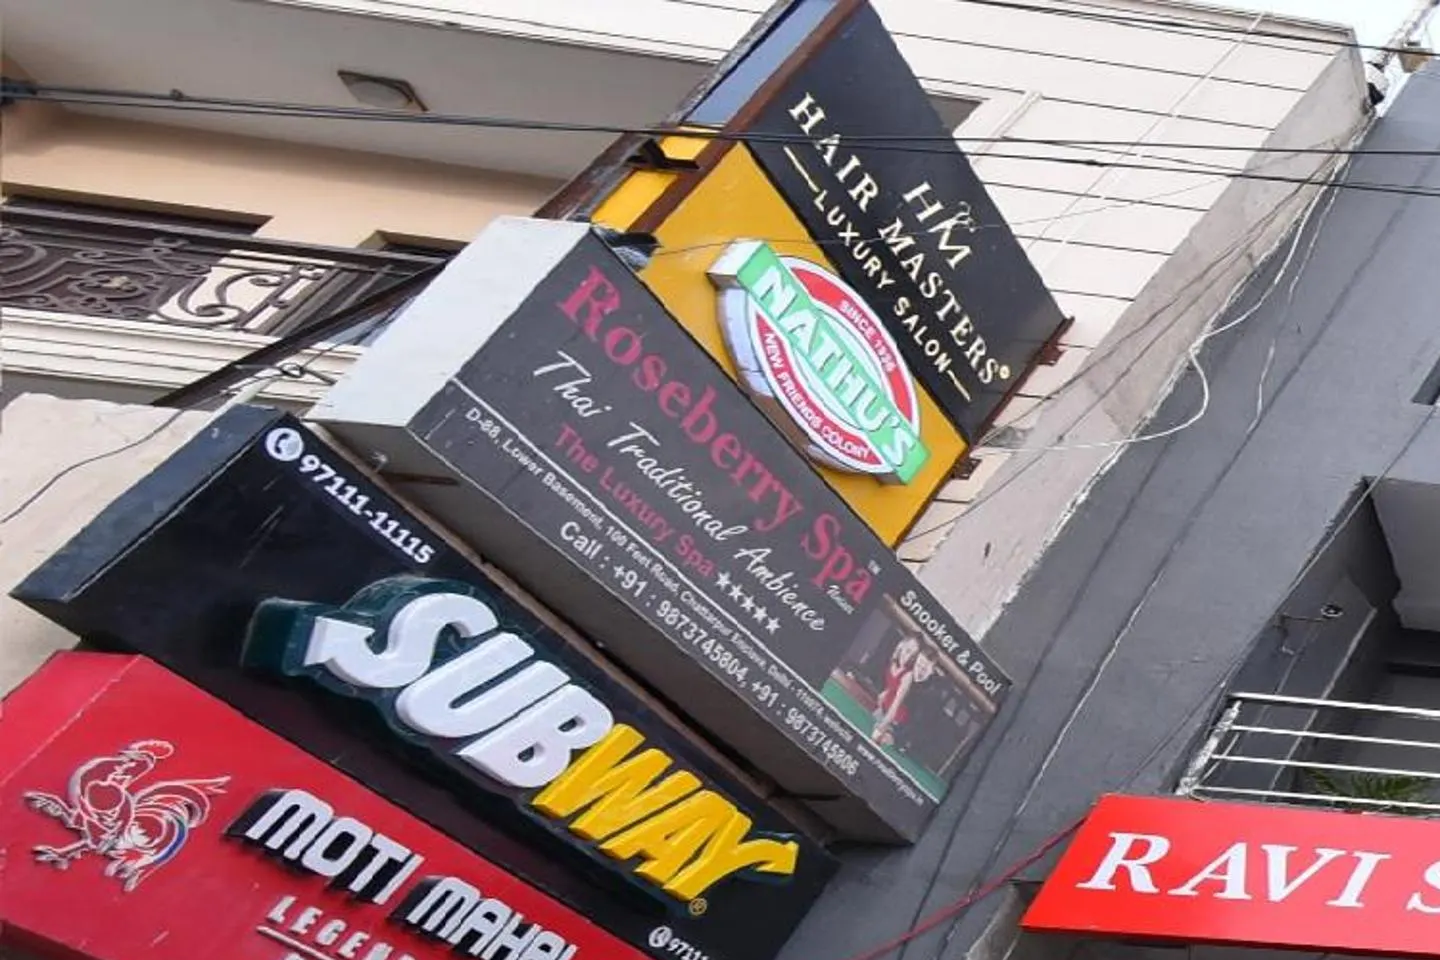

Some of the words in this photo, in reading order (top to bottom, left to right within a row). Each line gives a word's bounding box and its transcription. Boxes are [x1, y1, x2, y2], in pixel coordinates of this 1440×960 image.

[789, 91, 879, 213] HAIR
[814, 189, 896, 289] LUXURY
[894, 296, 952, 373] SALON
[839, 299, 877, 340] SINCE
[752, 265, 916, 467] NATHU'S
[763, 332, 785, 374] NEW
[777, 370, 822, 431] FRIENDS
[819, 425, 871, 459] COLONY
[533, 350, 612, 418] Thai
[606, 421, 748, 541] Traditional
[732, 547, 825, 631] Ambience
[554, 421, 600, 473] The
[599, 466, 676, 543] Luxury
[677, 533, 718, 578] Spa
[555, 265, 804, 532] Roseberry
[800, 512, 874, 604] Spa
[298, 452, 437, 565] 97111-11115
[501, 438, 545, 477] Lower
[605, 525, 629, 547] 100
[625, 542, 652, 569] Feet
[559, 521, 604, 559] Call
[613, 564, 648, 599] +91
[751, 680, 779, 708] +91
[900, 589, 960, 653] Snooker
[956, 650, 972, 666] &
[967, 660, 1003, 696] Pool
[303, 591, 799, 902] SUBWAY
[245, 787, 425, 906] MOTI
[1076, 829, 1392, 910] RAVI
